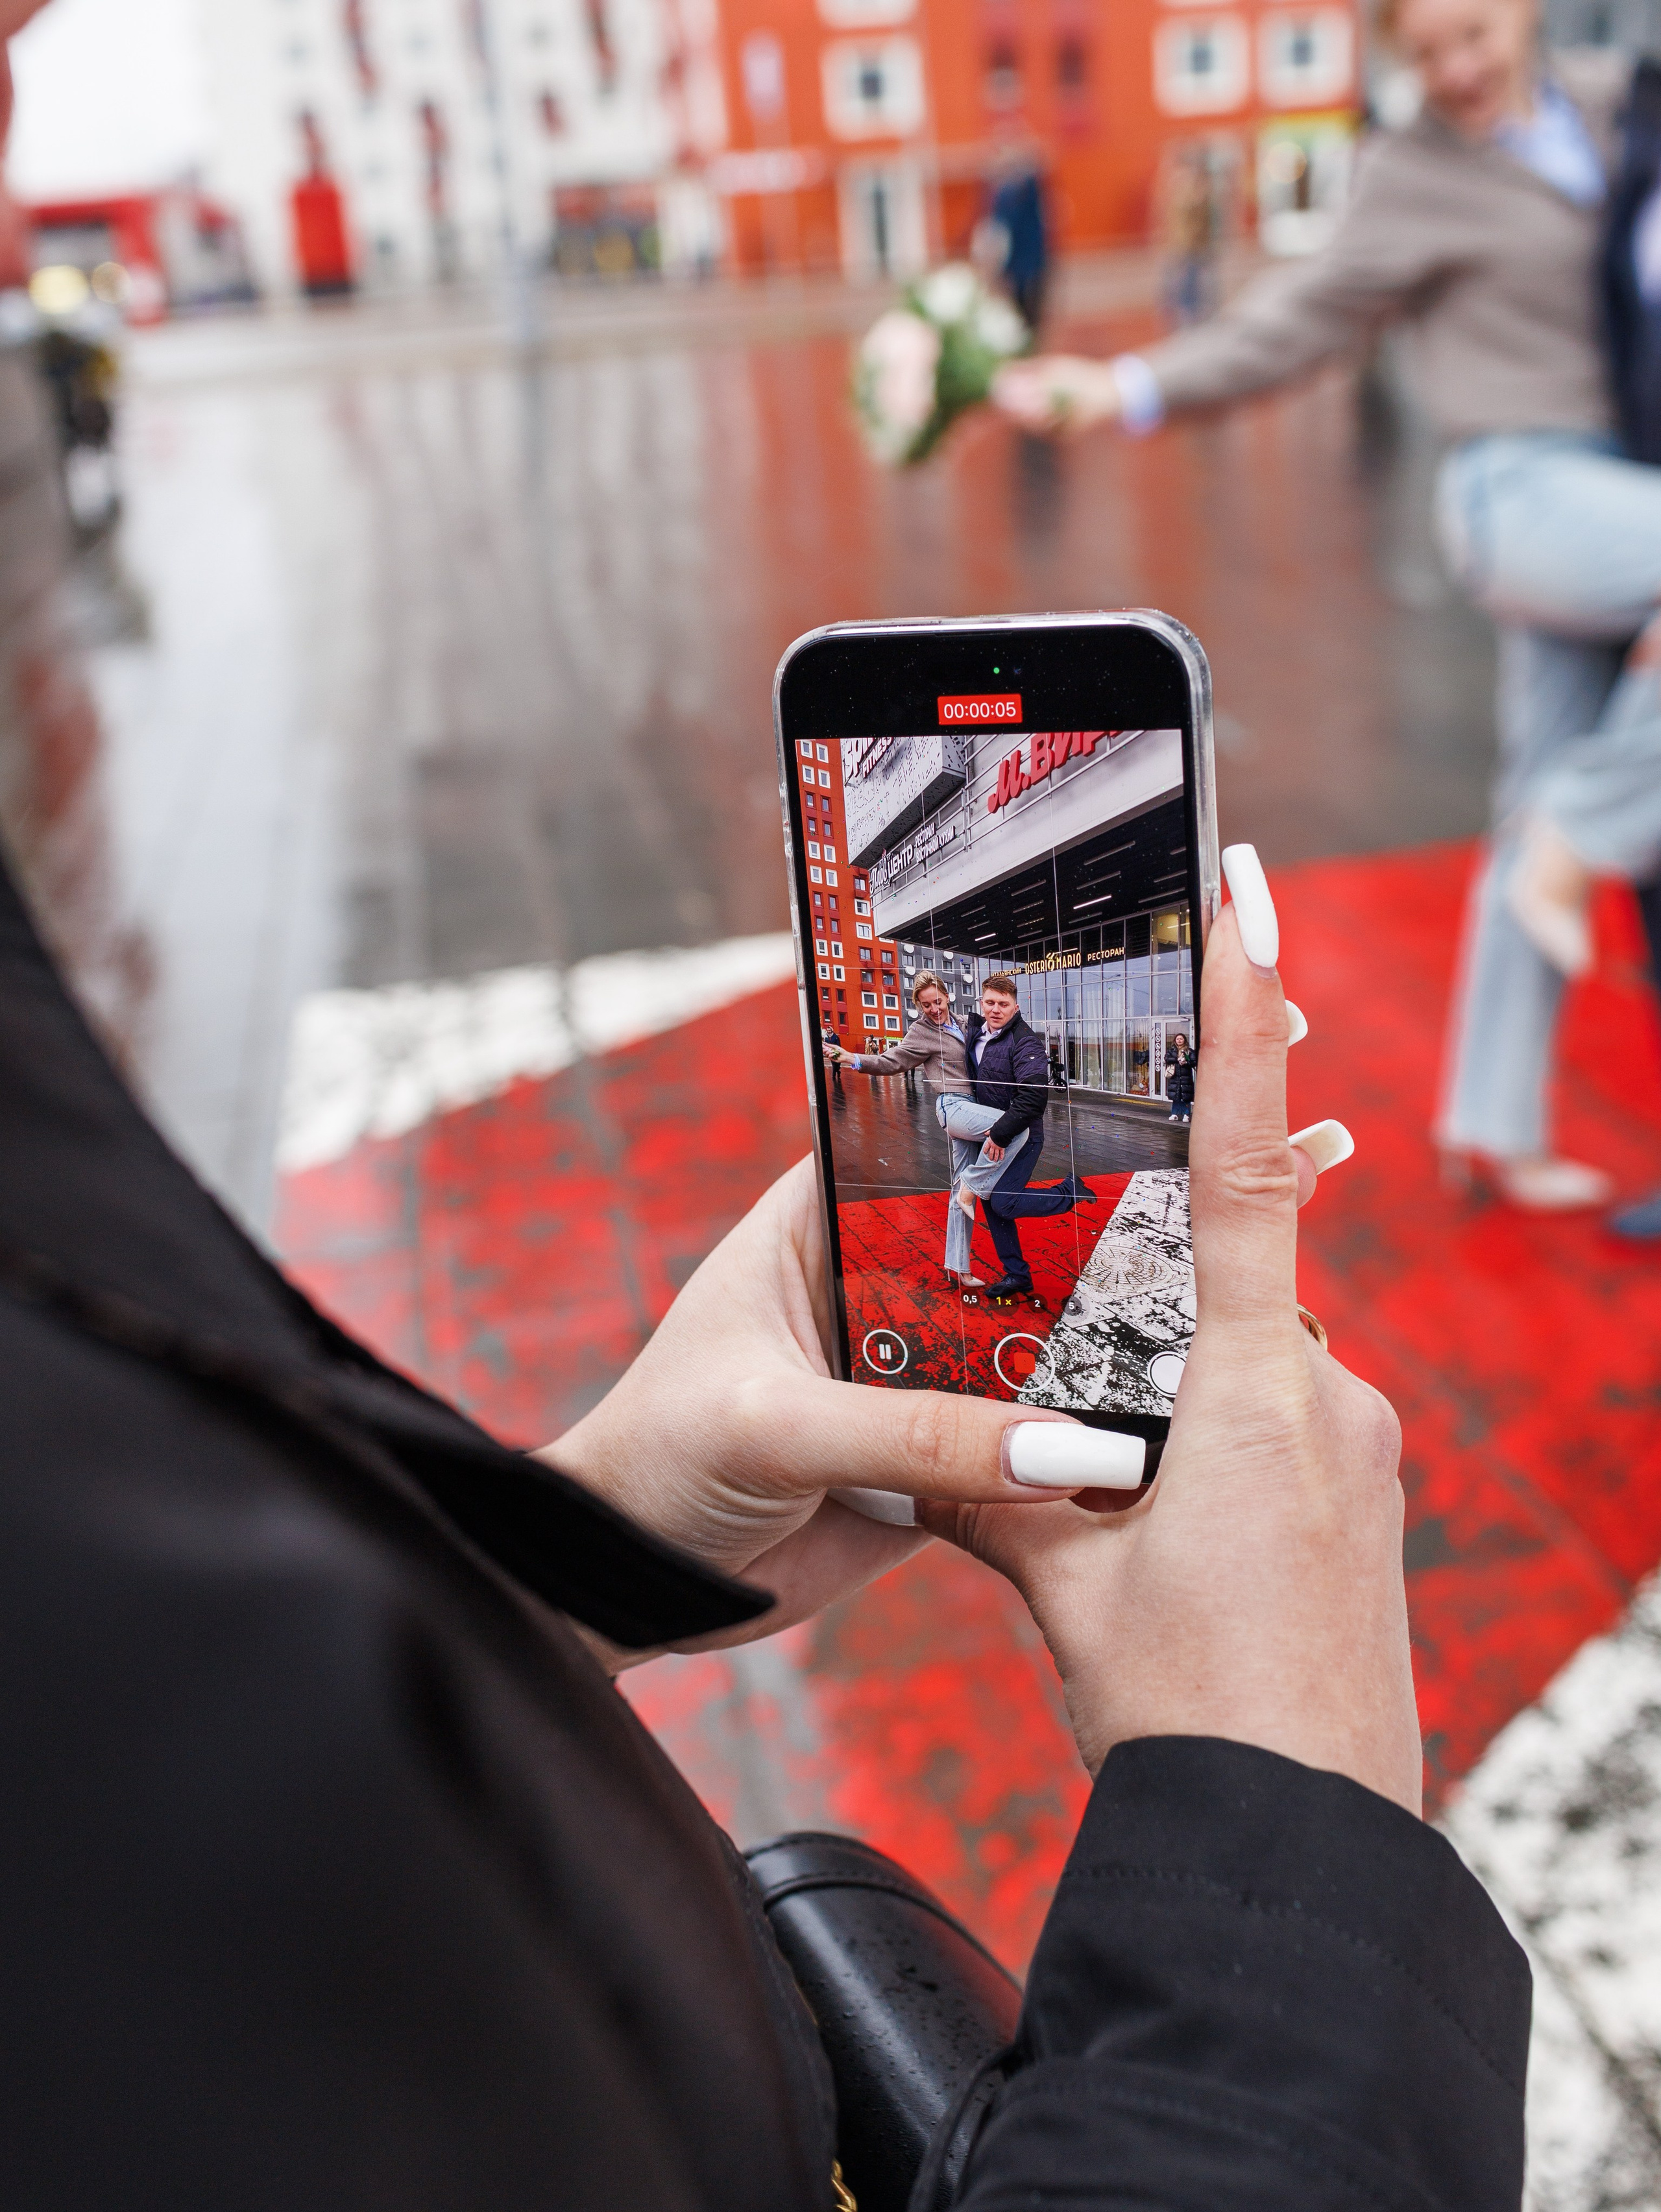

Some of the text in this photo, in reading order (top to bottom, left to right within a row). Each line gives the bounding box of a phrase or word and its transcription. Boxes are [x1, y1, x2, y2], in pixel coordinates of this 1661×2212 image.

[944, 702, 1016, 719] 00:00:05
[1087, 947, 1124, 961] РЕСТОРАН
[963, 1294, 978, 1304] 0,5
